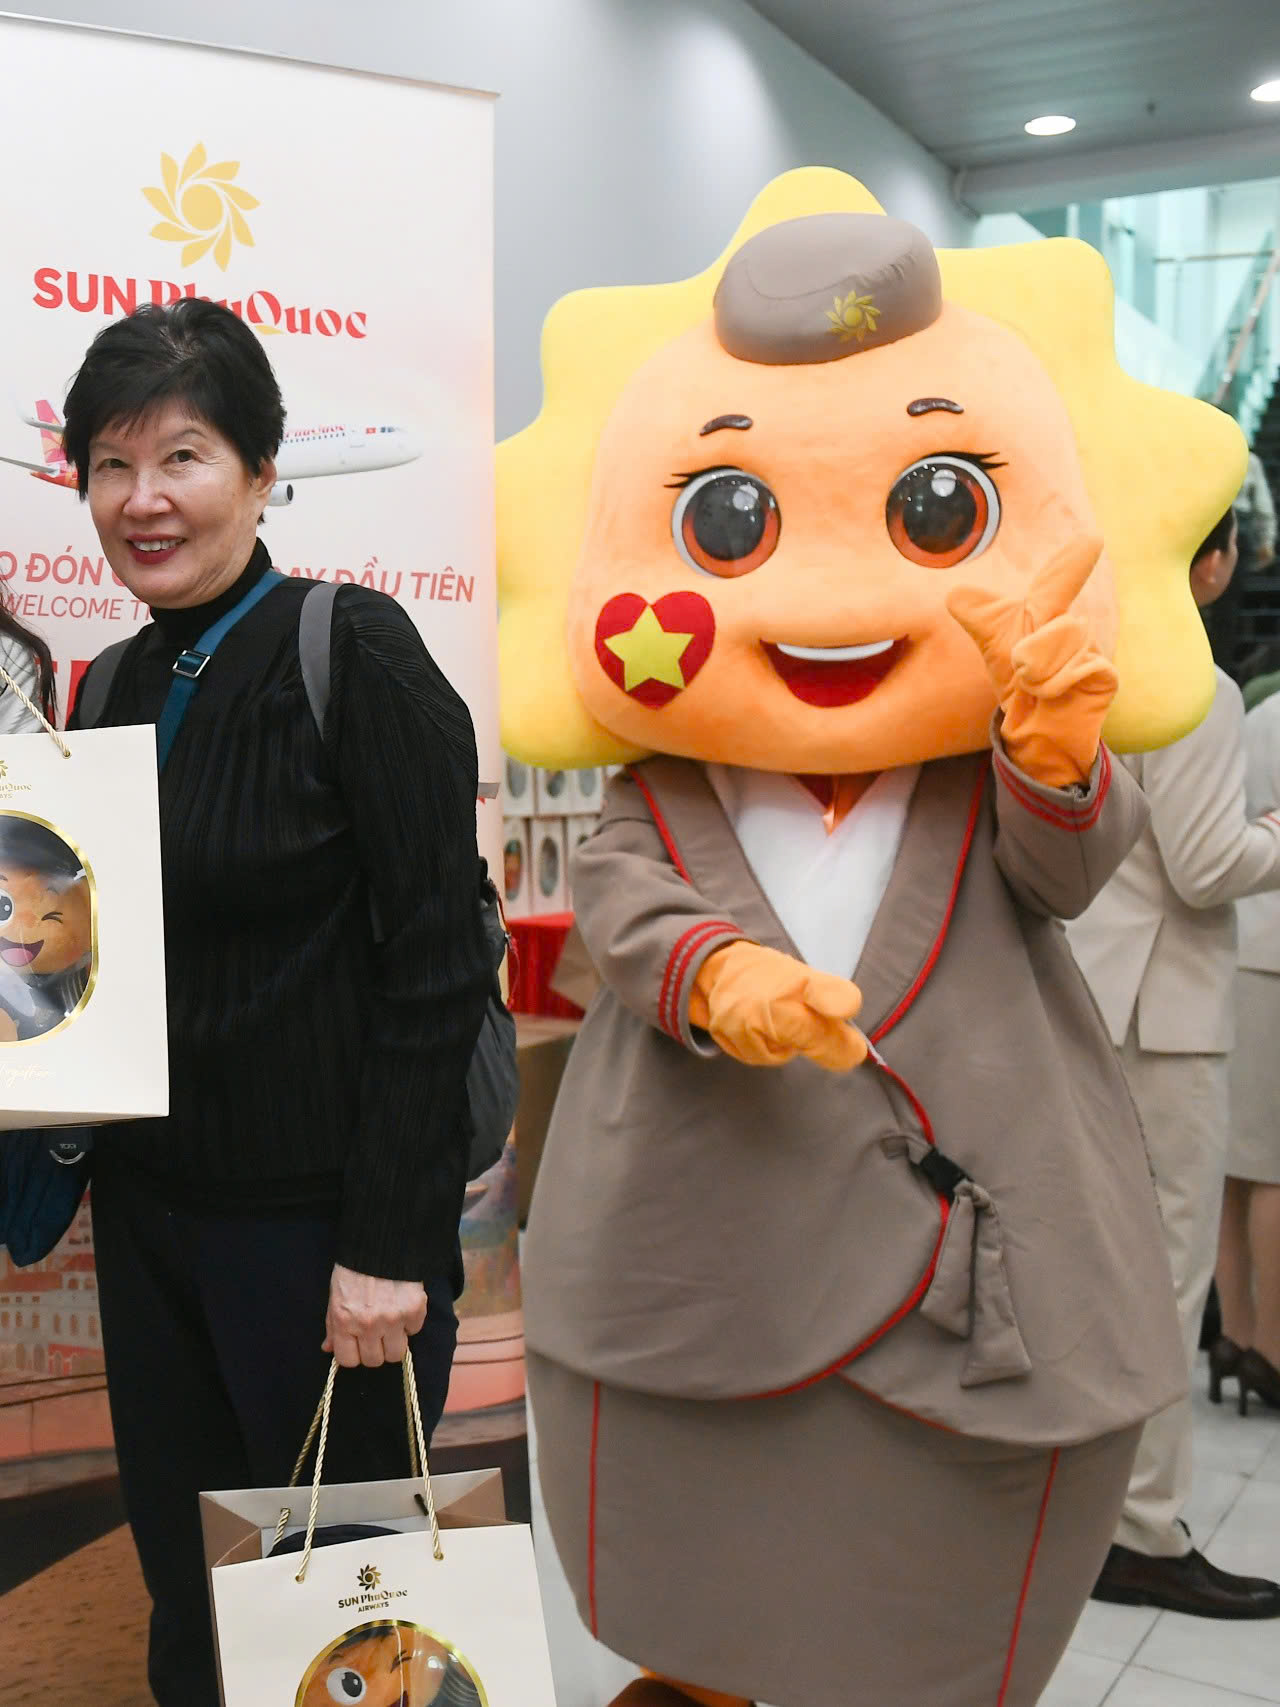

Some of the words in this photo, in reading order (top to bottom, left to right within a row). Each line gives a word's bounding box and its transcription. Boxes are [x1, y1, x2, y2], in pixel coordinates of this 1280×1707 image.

[32, 267, 137, 317] SUN
[24, 545, 105, 586] ĐÓN
[410, 565, 475, 603] TIÊN
[338, 1596, 360, 1609] SUN
[357, 1601, 390, 1613] AIRWAYS
